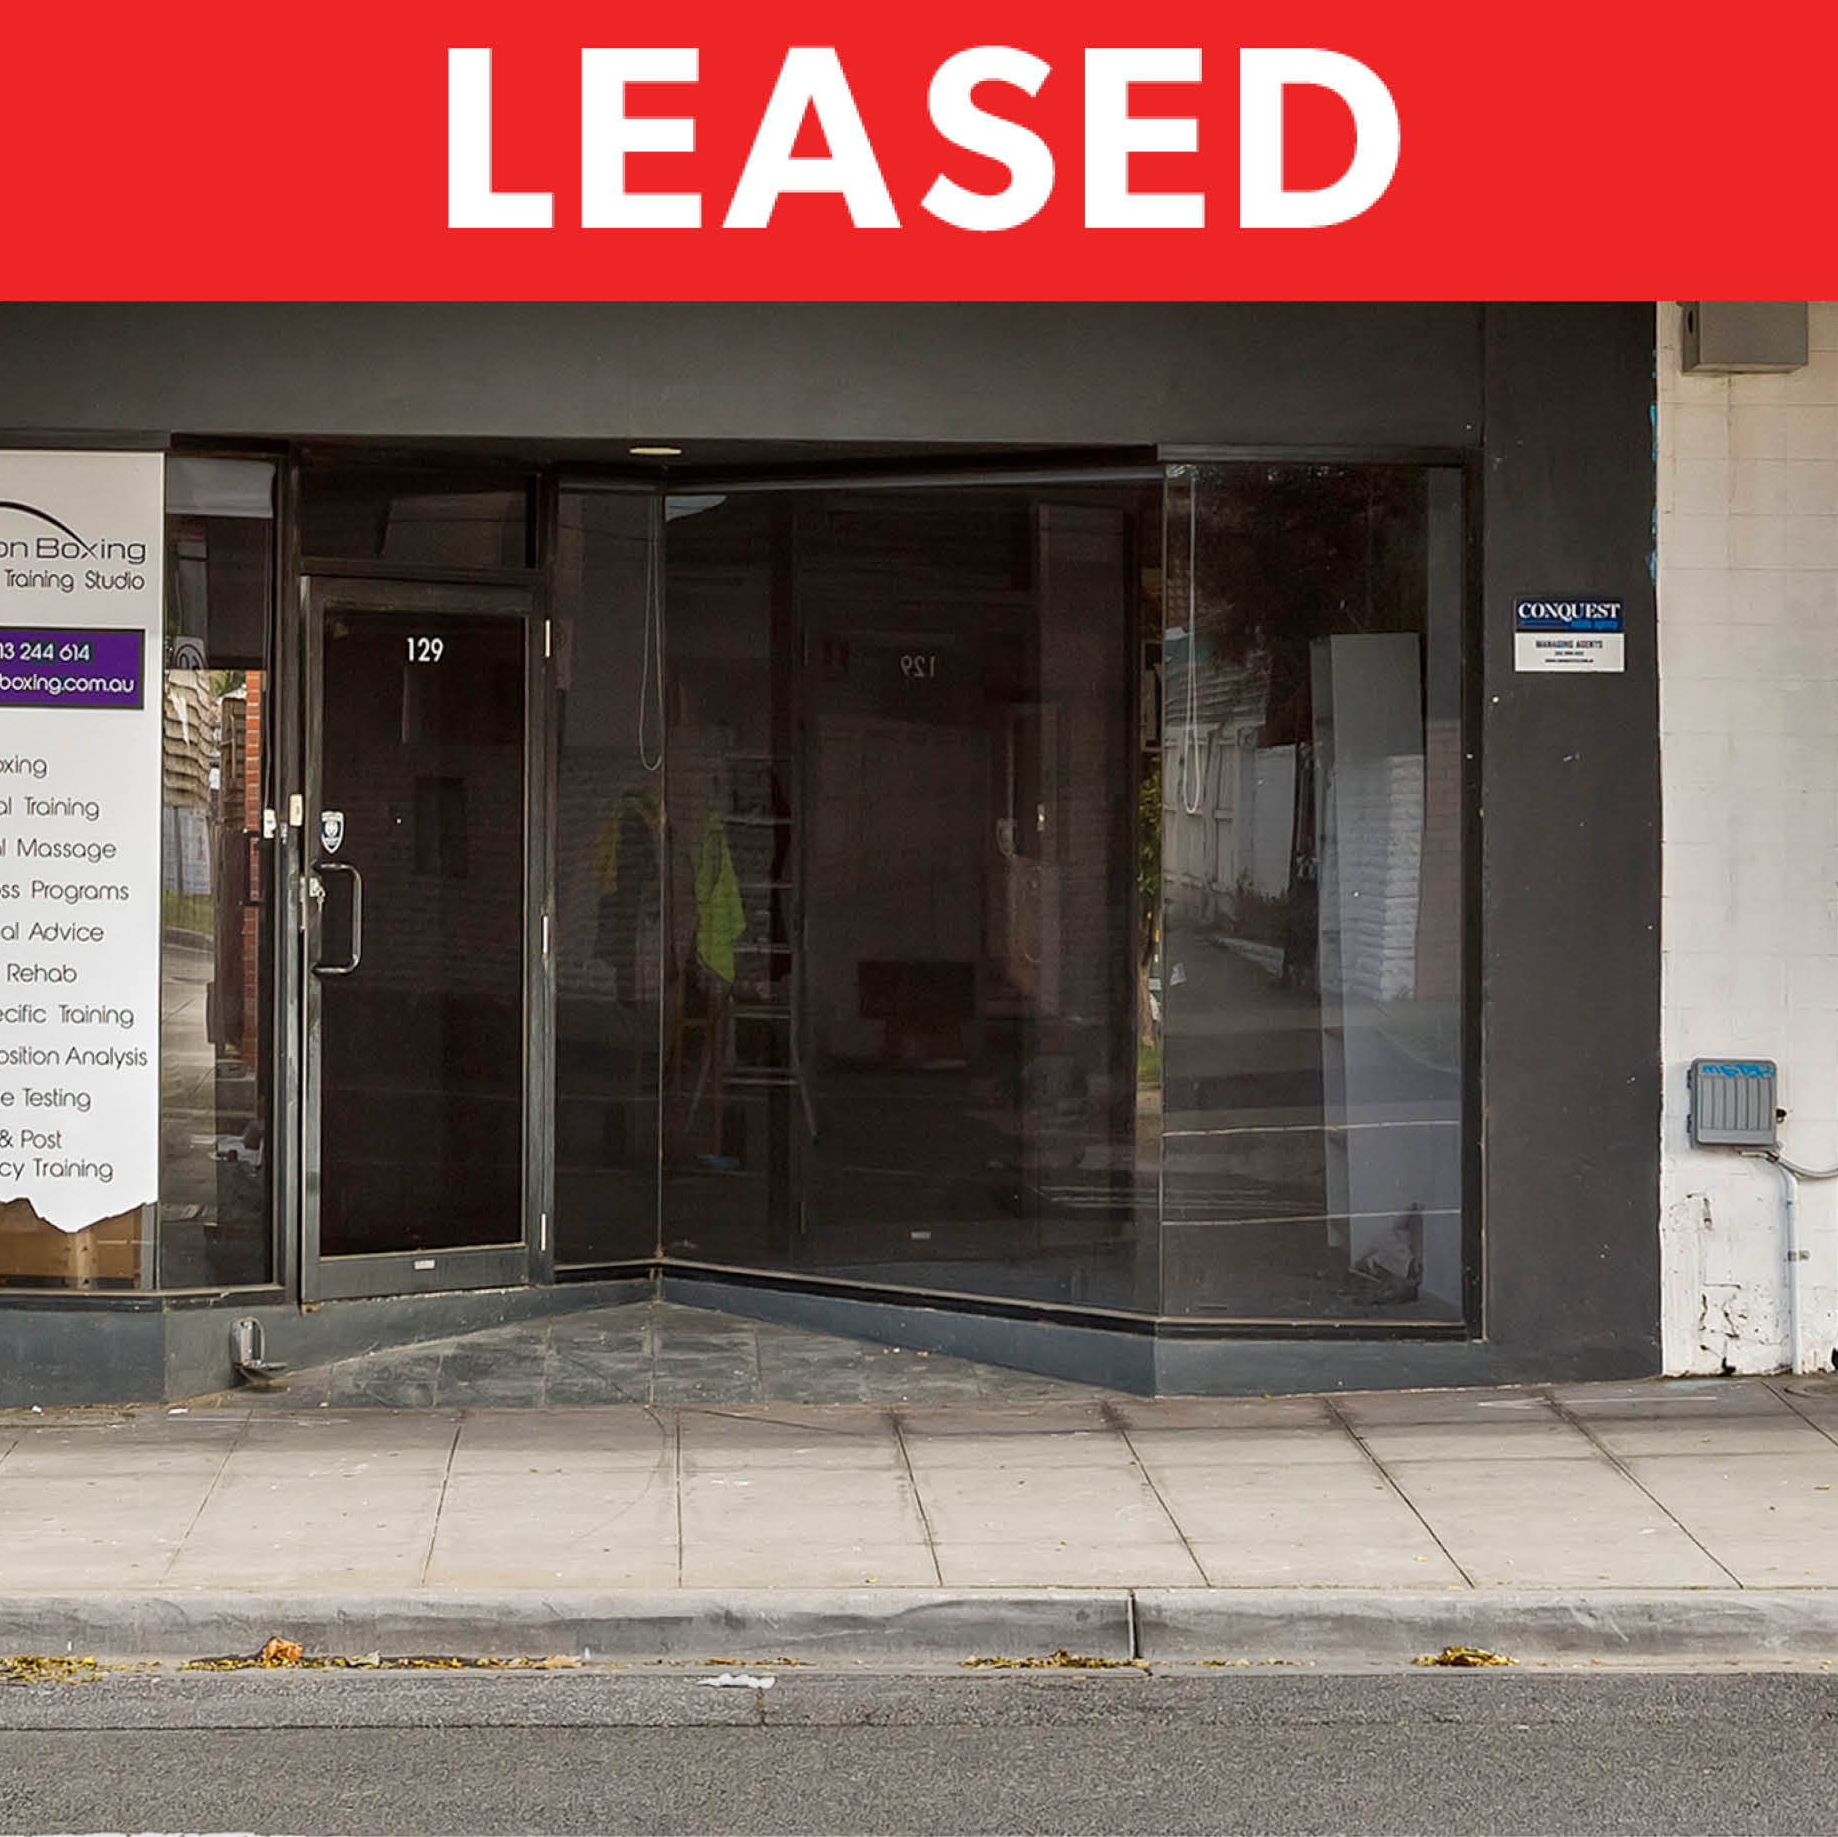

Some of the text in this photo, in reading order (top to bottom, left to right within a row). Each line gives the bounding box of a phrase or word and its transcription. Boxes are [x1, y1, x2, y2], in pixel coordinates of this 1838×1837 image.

[36, 537, 147, 564] Boxing
[5, 569, 74, 593] Training
[85, 570, 146, 590] Studio
[1518, 602, 1621, 622] CONQUEST
[19, 643, 54, 661] 244
[58, 644, 91, 662] 614
[405, 637, 444, 663] 129
[25, 796, 100, 821] Training
[17, 838, 117, 863] Massage
[31, 881, 130, 905] Programs
[28, 922, 105, 943] Advice
[6, 963, 77, 983] Rehab
[59, 1005, 134, 1029] Training
[65, 1046, 148, 1070] Analysis
[22, 1088, 92, 1112] Testing
[21, 1129, 62, 1149] Post
[32, 1159, 114, 1183] Training
